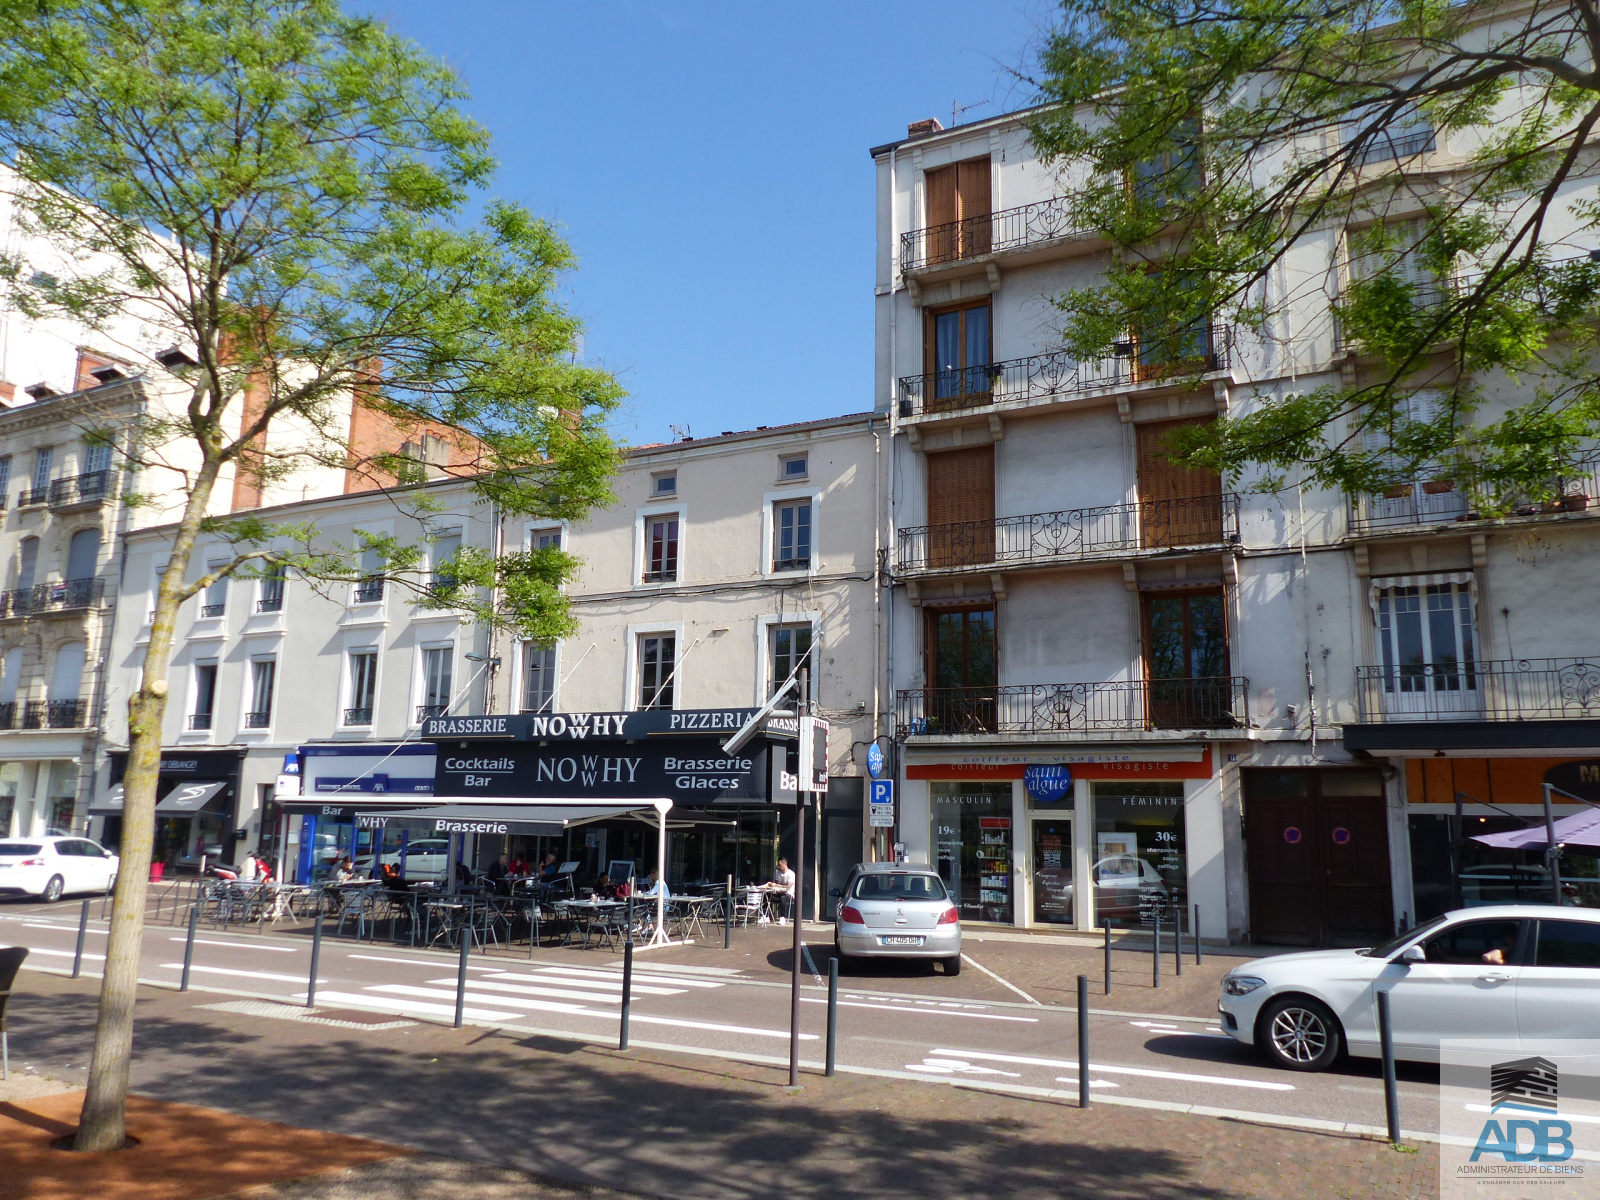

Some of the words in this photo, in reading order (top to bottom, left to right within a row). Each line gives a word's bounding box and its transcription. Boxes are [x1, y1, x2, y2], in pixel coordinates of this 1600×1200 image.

[428, 718, 507, 734] BRASSERIE
[670, 712, 754, 729] PIZZERIA
[445, 757, 515, 770] Cocktails
[664, 756, 753, 771] Brasserie
[1052, 754, 1130, 763] visagiste
[951, 763, 999, 771] coiffeur
[1103, 761, 1169, 772] visagiste
[464, 774, 492, 787] Bar
[675, 775, 740, 789] Glaces
[780, 770, 798, 791] Ba
[1028, 774, 1068, 796] algue
[875, 784, 887, 800] P
[936, 796, 992, 804] MASCULIN
[1122, 796, 1178, 806] FÉMININ
[322, 805, 344, 815] Bar
[435, 819, 508, 834] Brasserie
